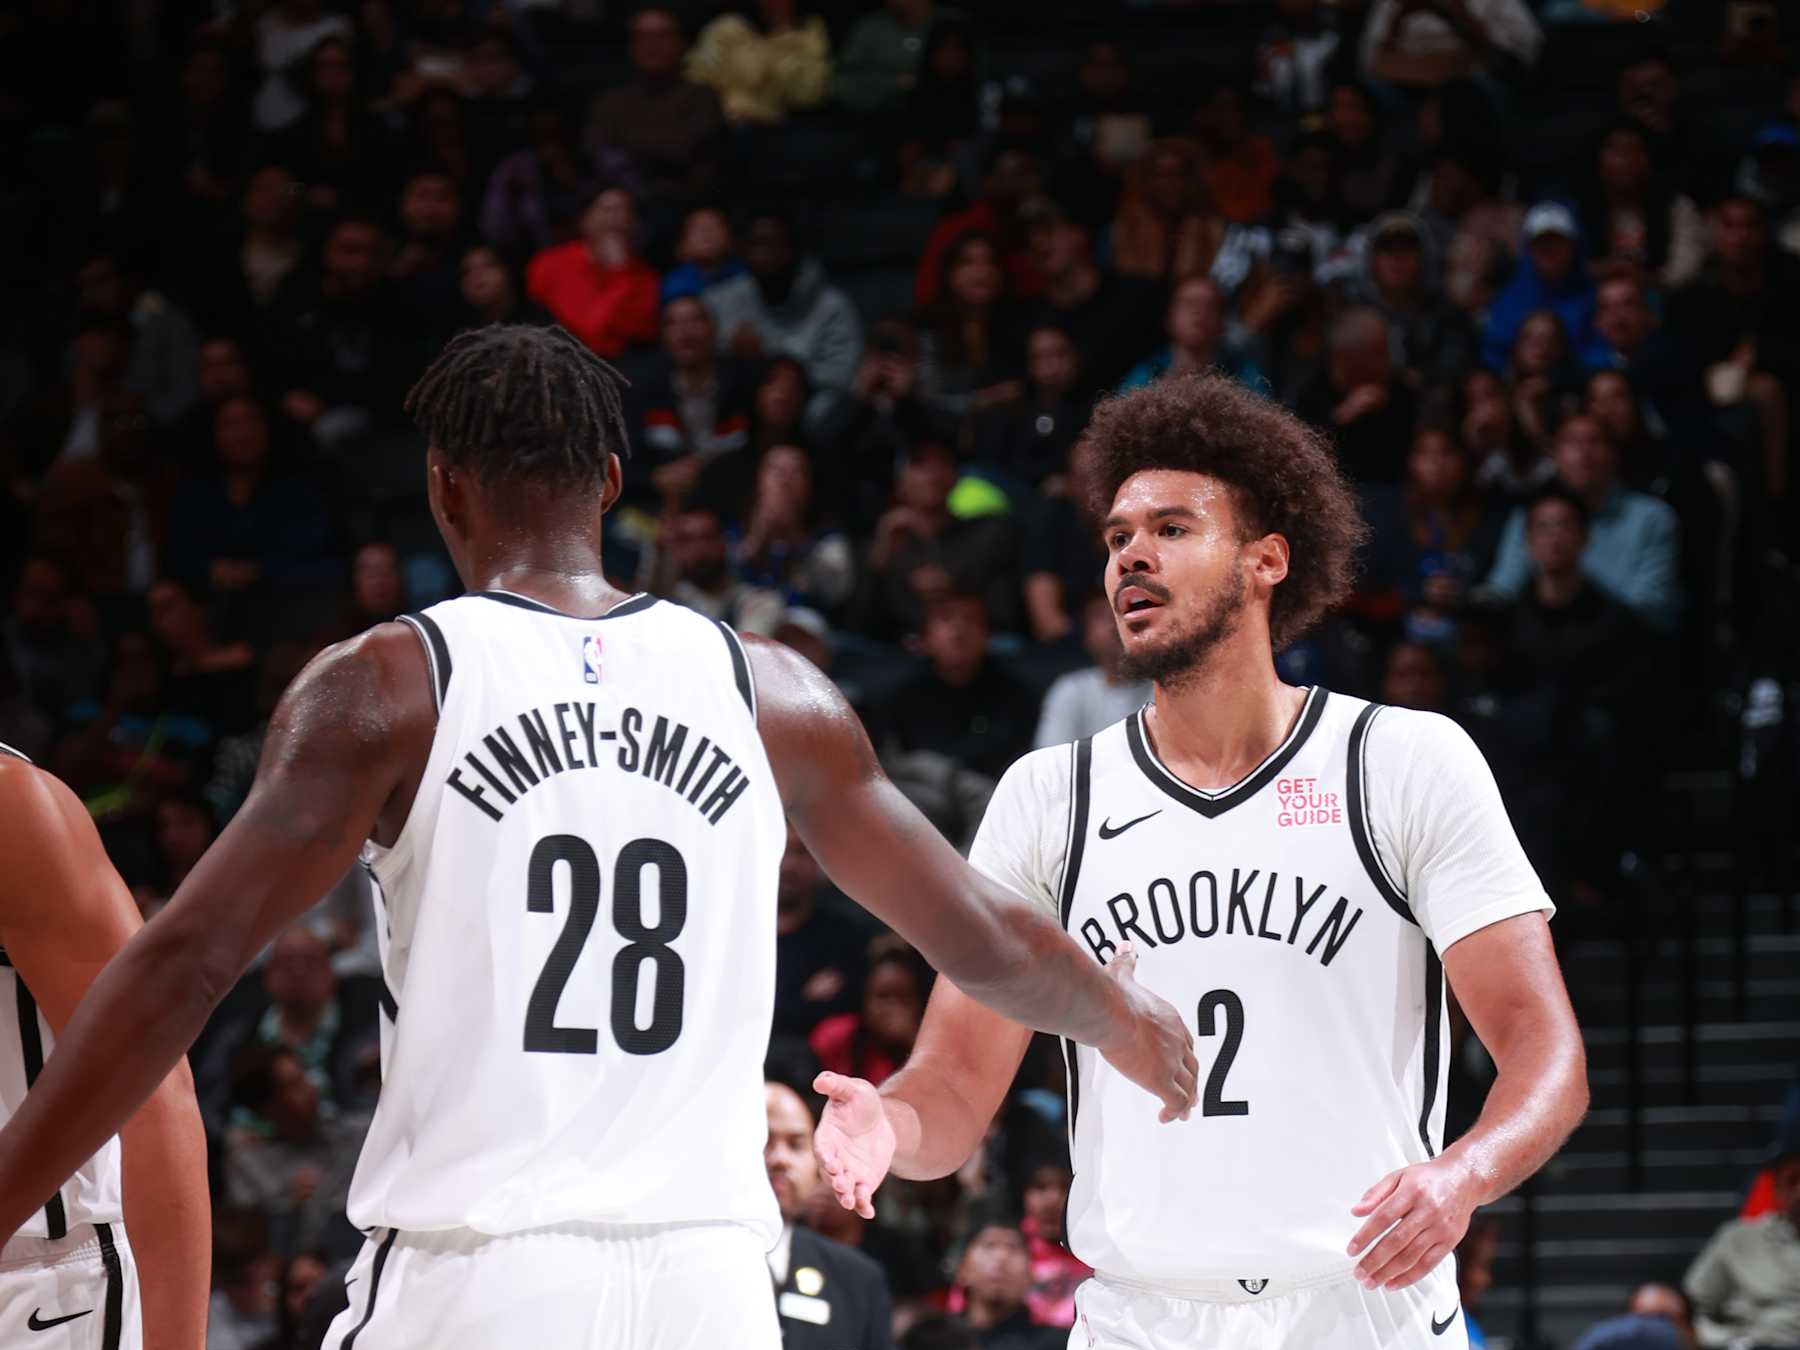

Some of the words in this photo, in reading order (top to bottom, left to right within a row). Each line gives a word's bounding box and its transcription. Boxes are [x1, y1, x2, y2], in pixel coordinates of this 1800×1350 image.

[446, 701, 750, 826] FINNEY-SMITH
[1277, 778, 1317, 794] GET
[1278, 793, 1338, 810] YOUR
[1278, 809, 1342, 827] GUIDE
[523, 834, 688, 1055] 28
[1080, 868, 1364, 967] BROOKLYN
[1197, 989, 1249, 1117] 2
